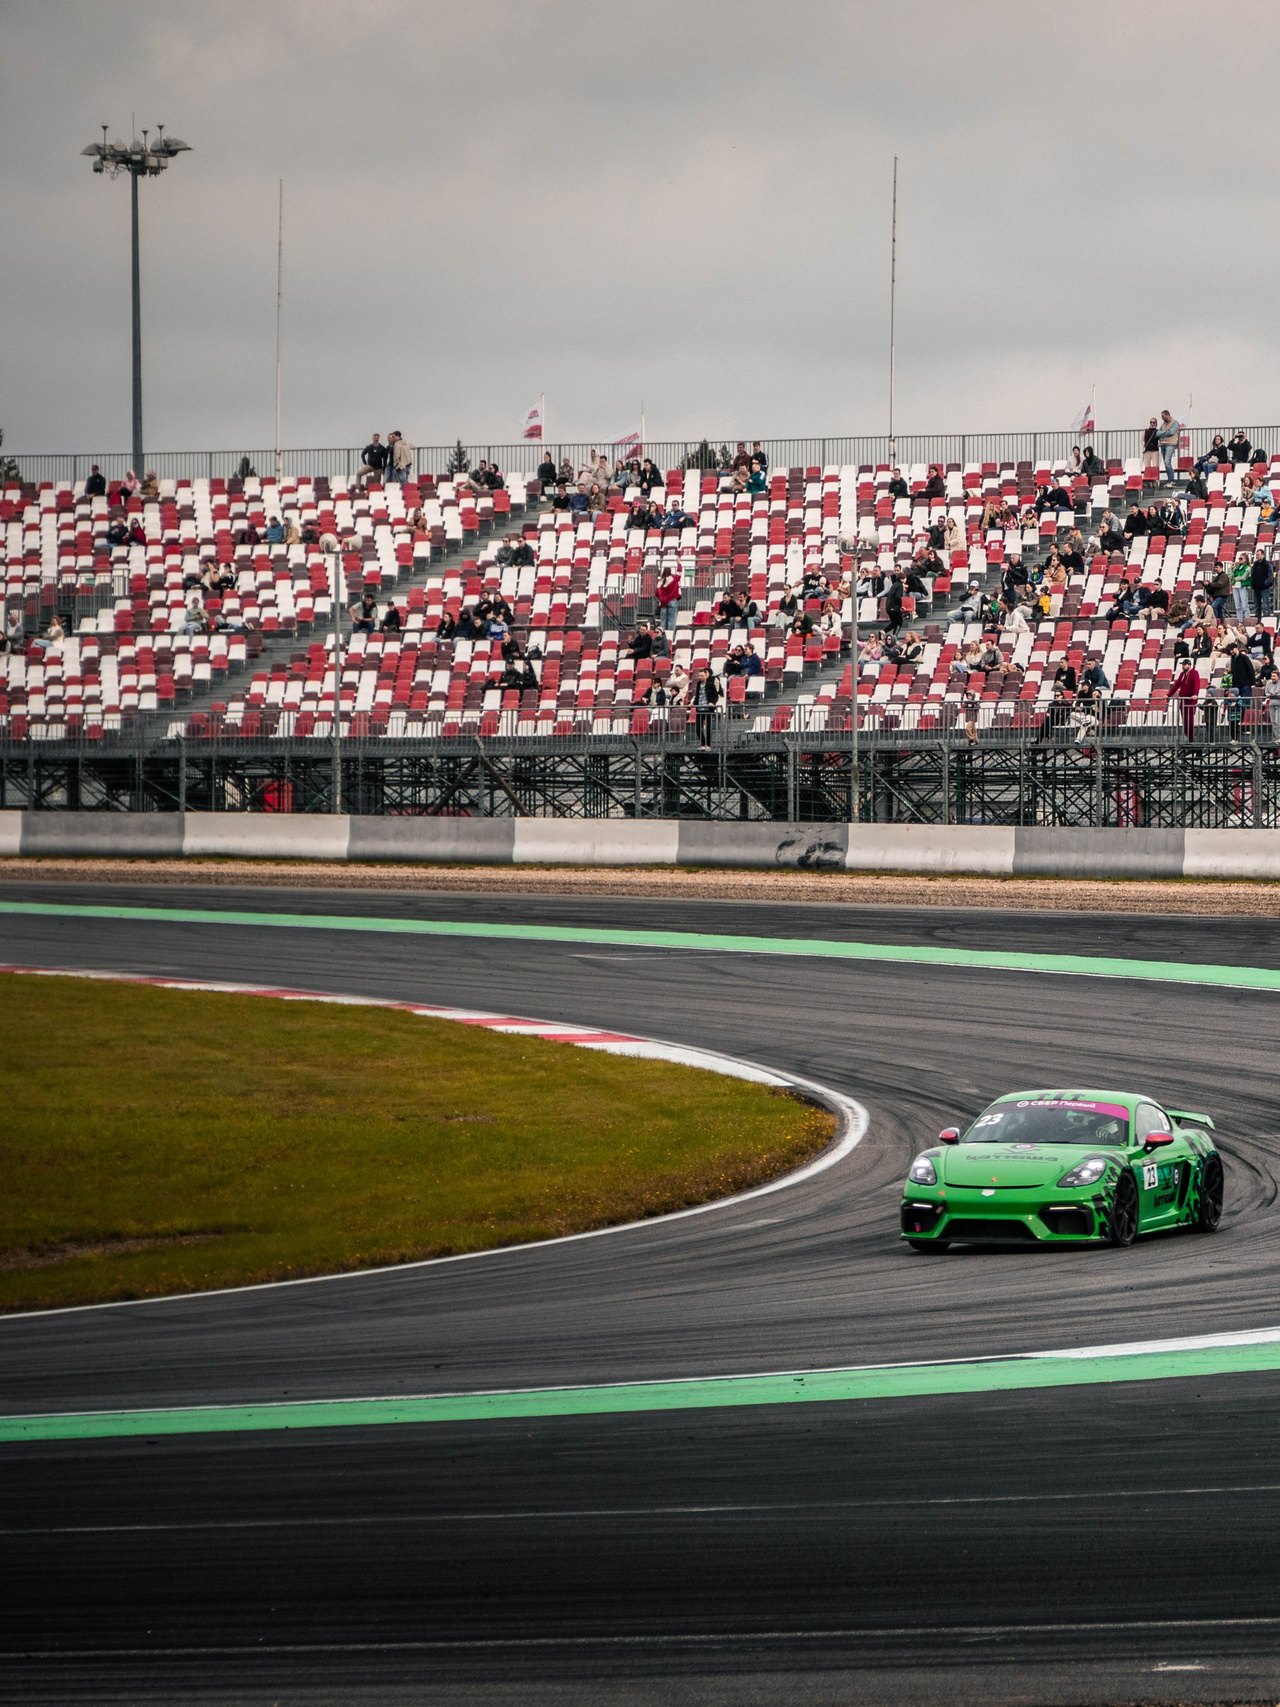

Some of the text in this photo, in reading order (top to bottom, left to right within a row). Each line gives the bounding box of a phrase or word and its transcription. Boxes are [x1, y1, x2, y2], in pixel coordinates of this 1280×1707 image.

[1059, 1100, 1096, 1108] Первый
[974, 1113, 1004, 1129] 23
[1147, 1166, 1157, 1188] 23
